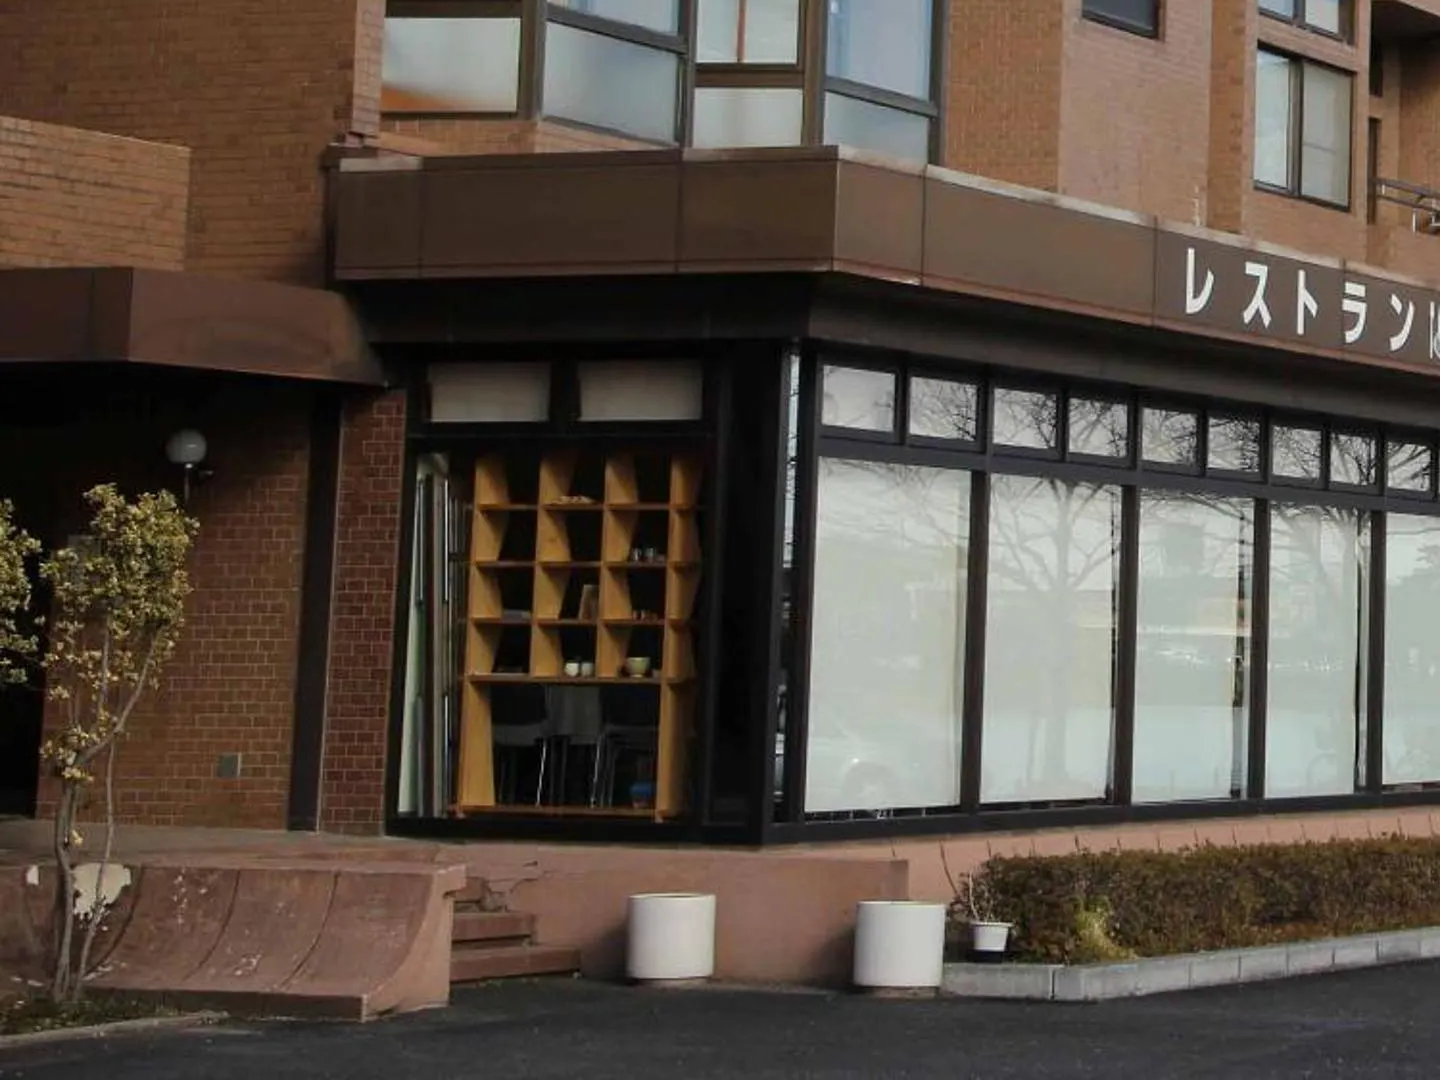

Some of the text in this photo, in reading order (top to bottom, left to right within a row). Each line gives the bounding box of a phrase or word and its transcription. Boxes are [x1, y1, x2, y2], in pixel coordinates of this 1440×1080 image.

[1185, 247, 1414, 352] レストラン
